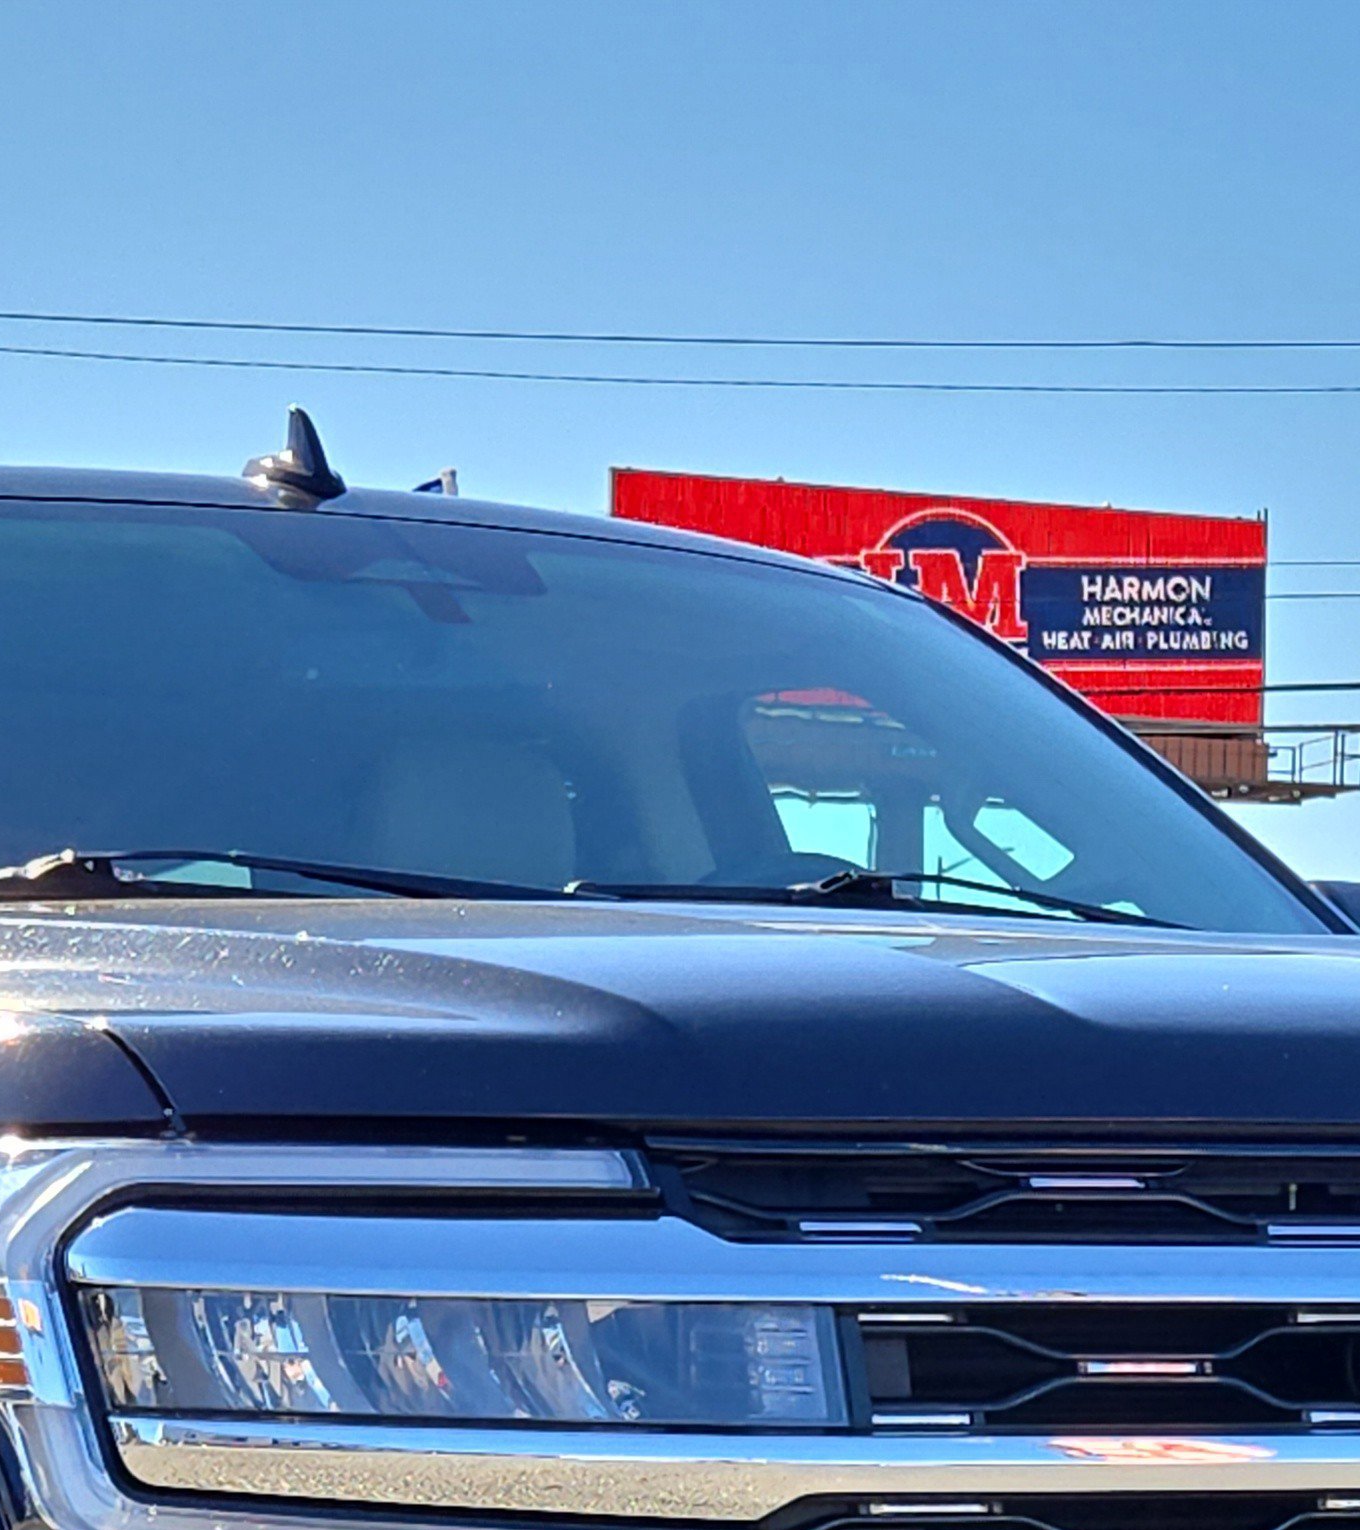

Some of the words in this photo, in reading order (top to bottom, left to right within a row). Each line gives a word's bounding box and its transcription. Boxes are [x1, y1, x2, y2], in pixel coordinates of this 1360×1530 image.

[1081, 574, 1213, 604] HARMON
[1042, 630, 1091, 650] HEAT
[1100, 630, 1134, 650] AIR
[1146, 630, 1249, 651] PLUMBING
